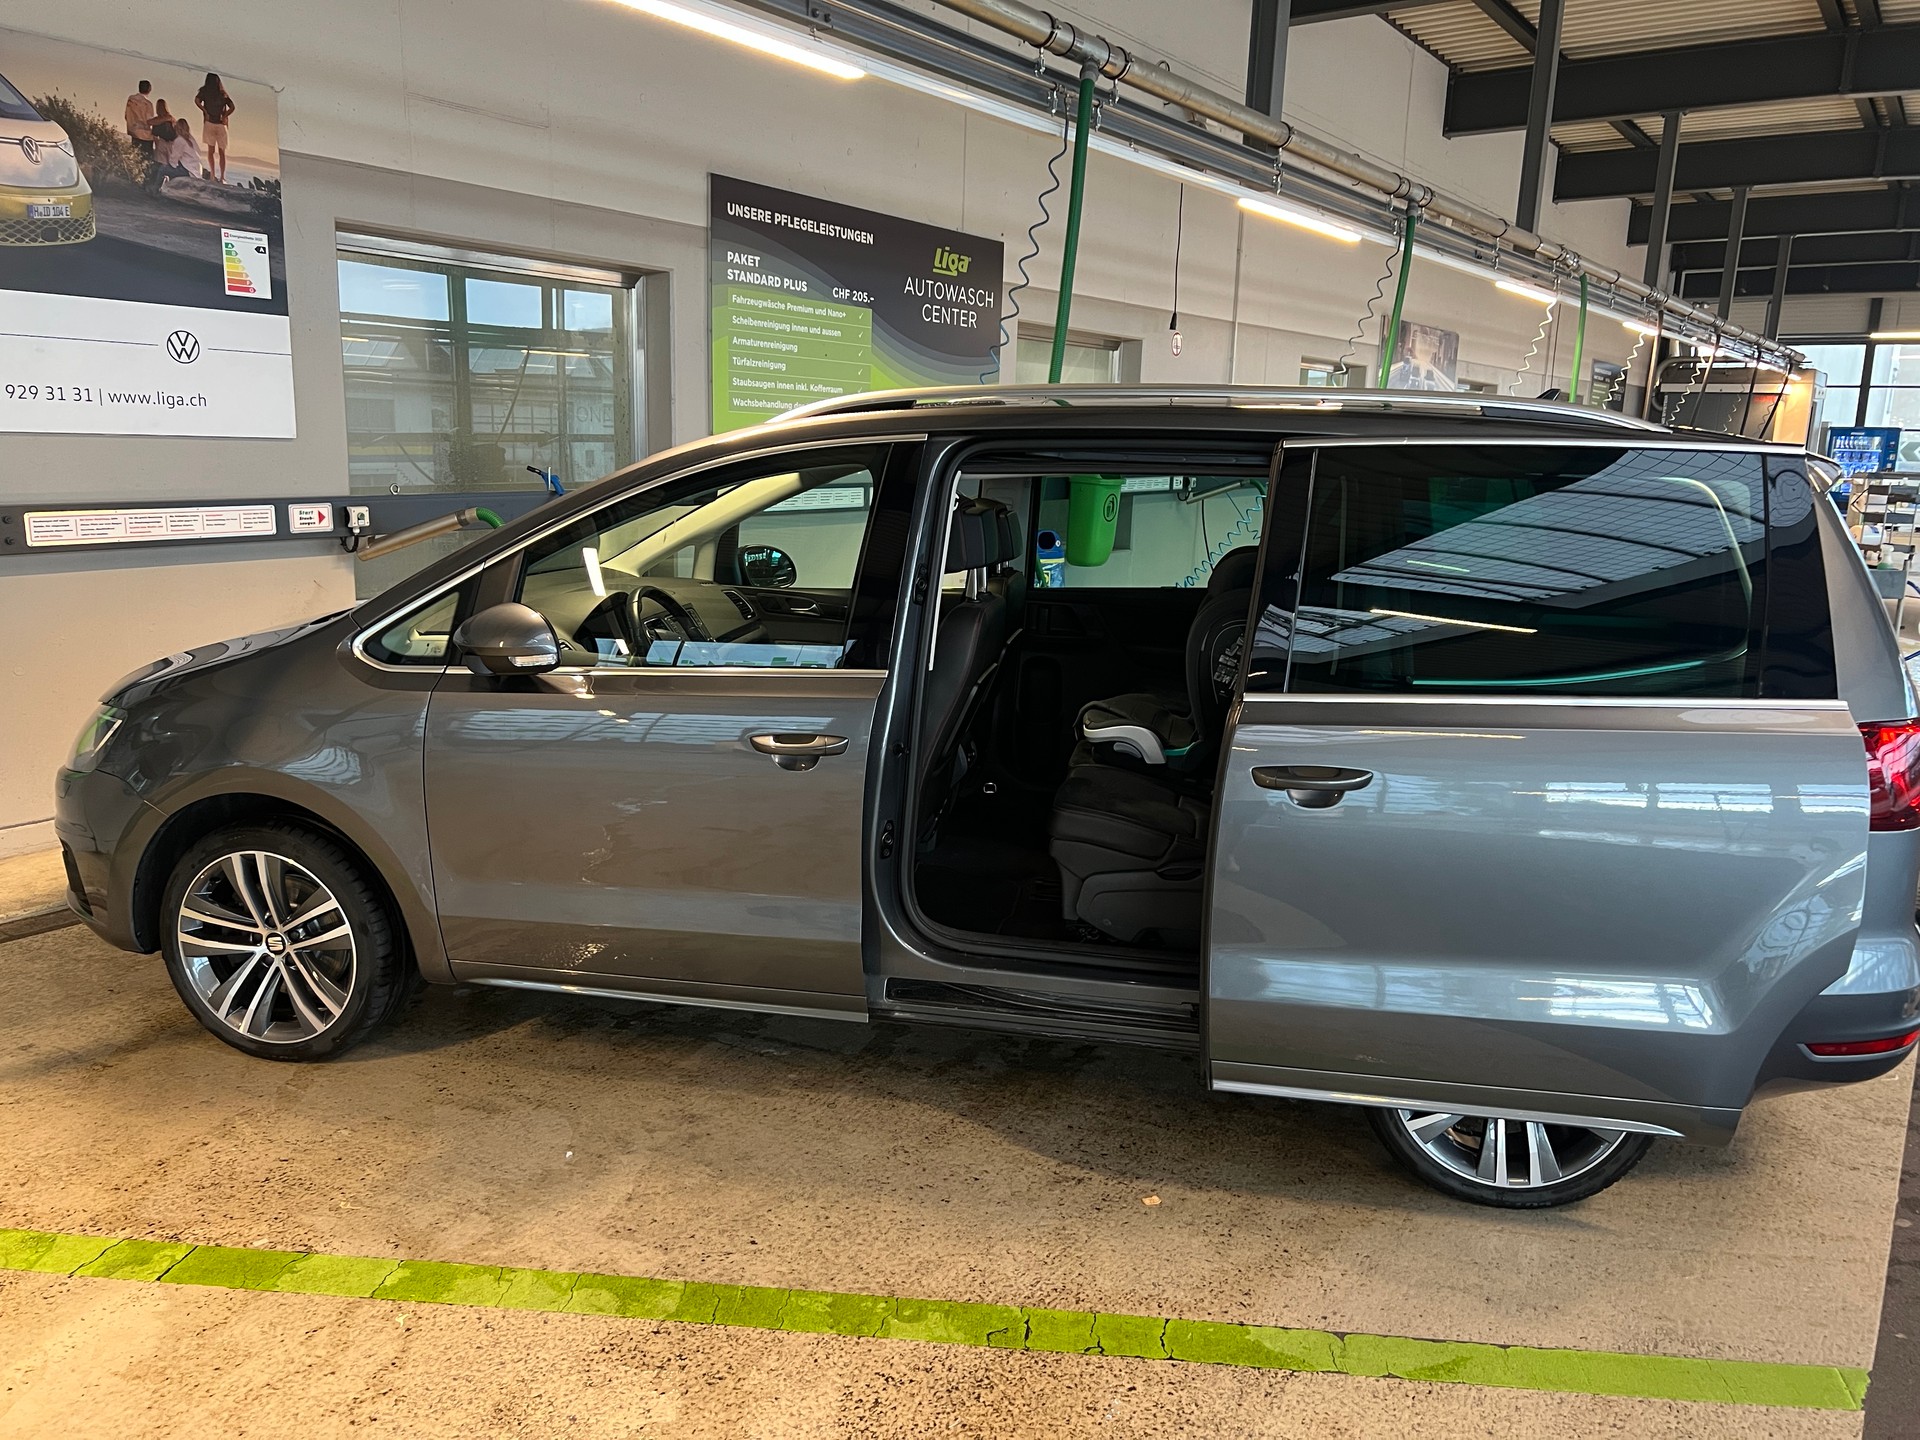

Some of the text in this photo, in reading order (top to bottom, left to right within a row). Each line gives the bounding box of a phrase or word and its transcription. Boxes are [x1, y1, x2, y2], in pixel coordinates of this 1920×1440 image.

[727, 202, 874, 244] UNSERE PFLEGELEISTUNGEN
[727, 252, 760, 267] PAKET
[727, 269, 808, 292] STANDARD PLUS
[832, 287, 874, 303] CHF 205.-
[904, 276, 994, 308] AUTOWASCH
[732, 295, 786, 310] Fahrzeugwäsche
[786, 303, 814, 314] Premium
[828, 309, 846, 318] Nano+
[732, 315, 790, 332] Scheibenreinigung
[792, 324, 808, 333] innen
[922, 304, 977, 328] CENTER
[732, 336, 798, 352] Armaturenreinigung
[732, 357, 786, 371] Türfalzreinigung
[732, 377, 843, 393] Staubsaugen innen inkl. Kofferraum
[5, 384, 207, 409] 929 31 31 www.liga.ch
[732, 398, 792, 410] Wachsbehandlung
